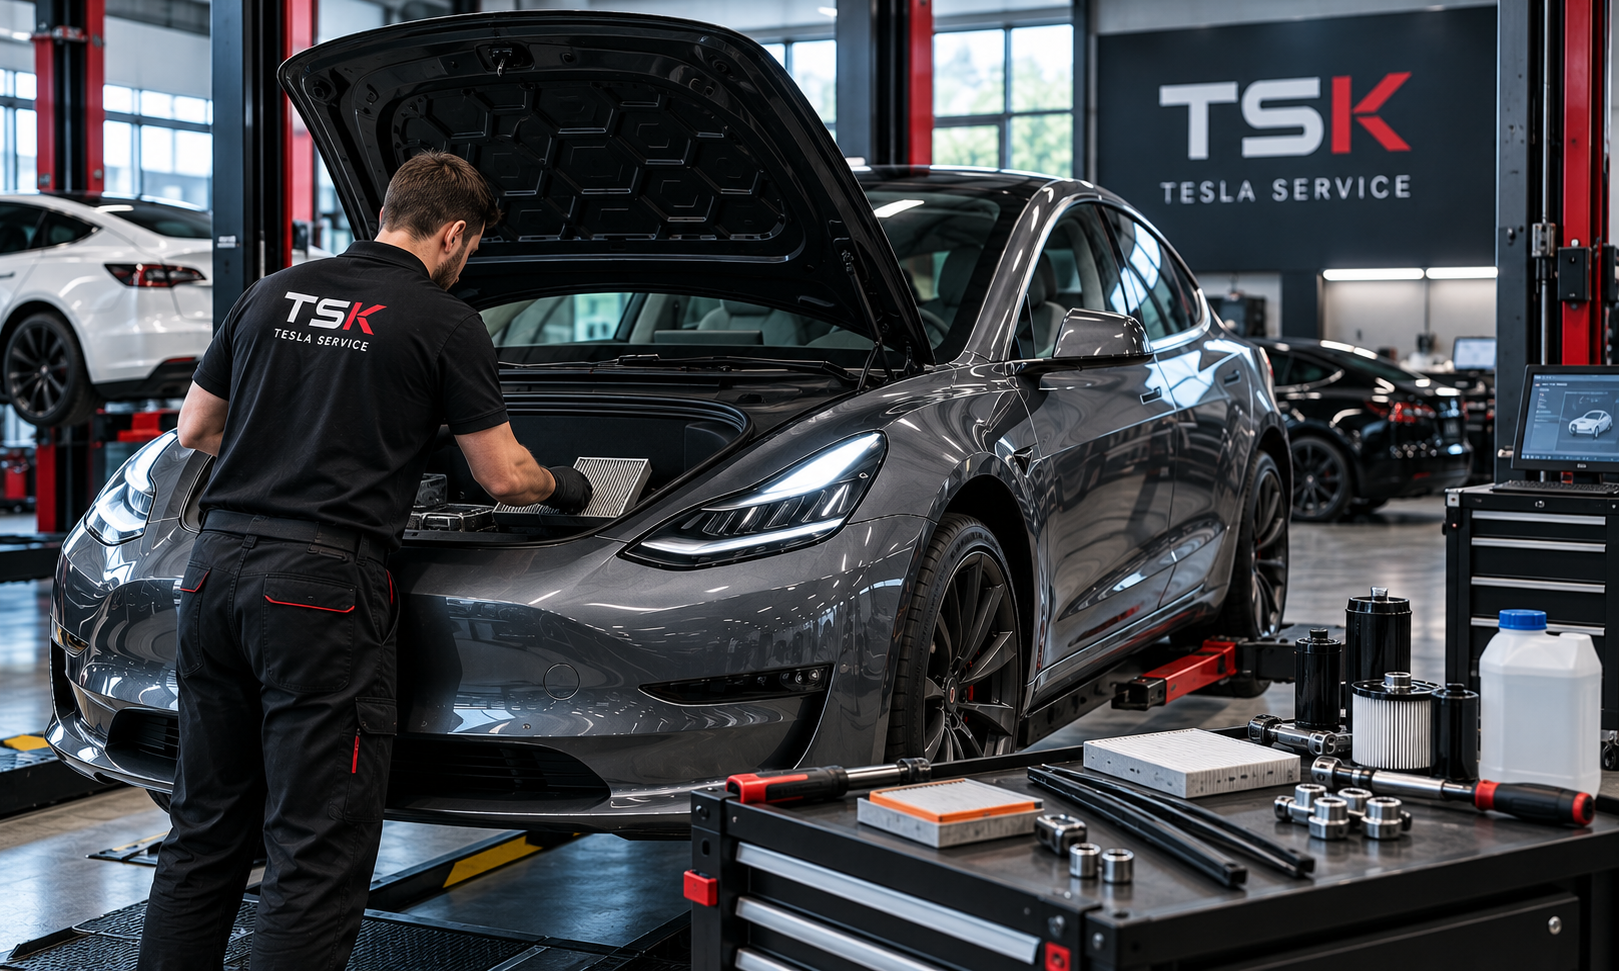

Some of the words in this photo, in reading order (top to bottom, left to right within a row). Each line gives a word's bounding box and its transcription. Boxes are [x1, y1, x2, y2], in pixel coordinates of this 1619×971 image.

[1159, 72, 1412, 160] TSK
[1160, 180, 1256, 204] TESLA
[1272, 174, 1411, 202] SERVICE
[284, 291, 388, 336] TSK
[274, 328, 311, 344] TESLA
[316, 335, 370, 352] SERVICE
